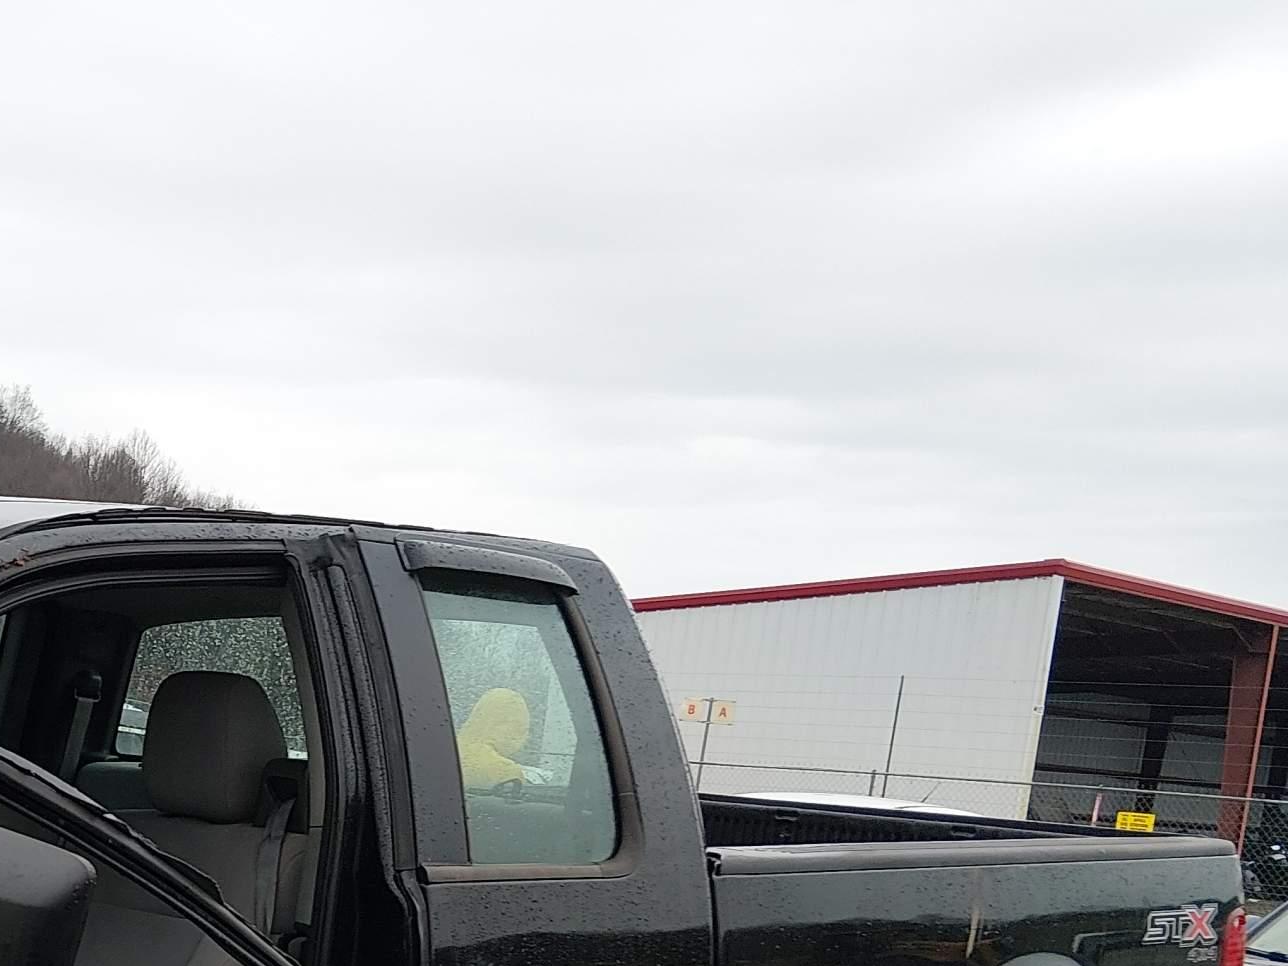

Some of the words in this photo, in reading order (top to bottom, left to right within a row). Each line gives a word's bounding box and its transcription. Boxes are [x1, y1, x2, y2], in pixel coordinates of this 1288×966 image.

[687, 704, 696, 715] B
[718, 707, 728, 718] A
[1141, 902, 1219, 948] STX
